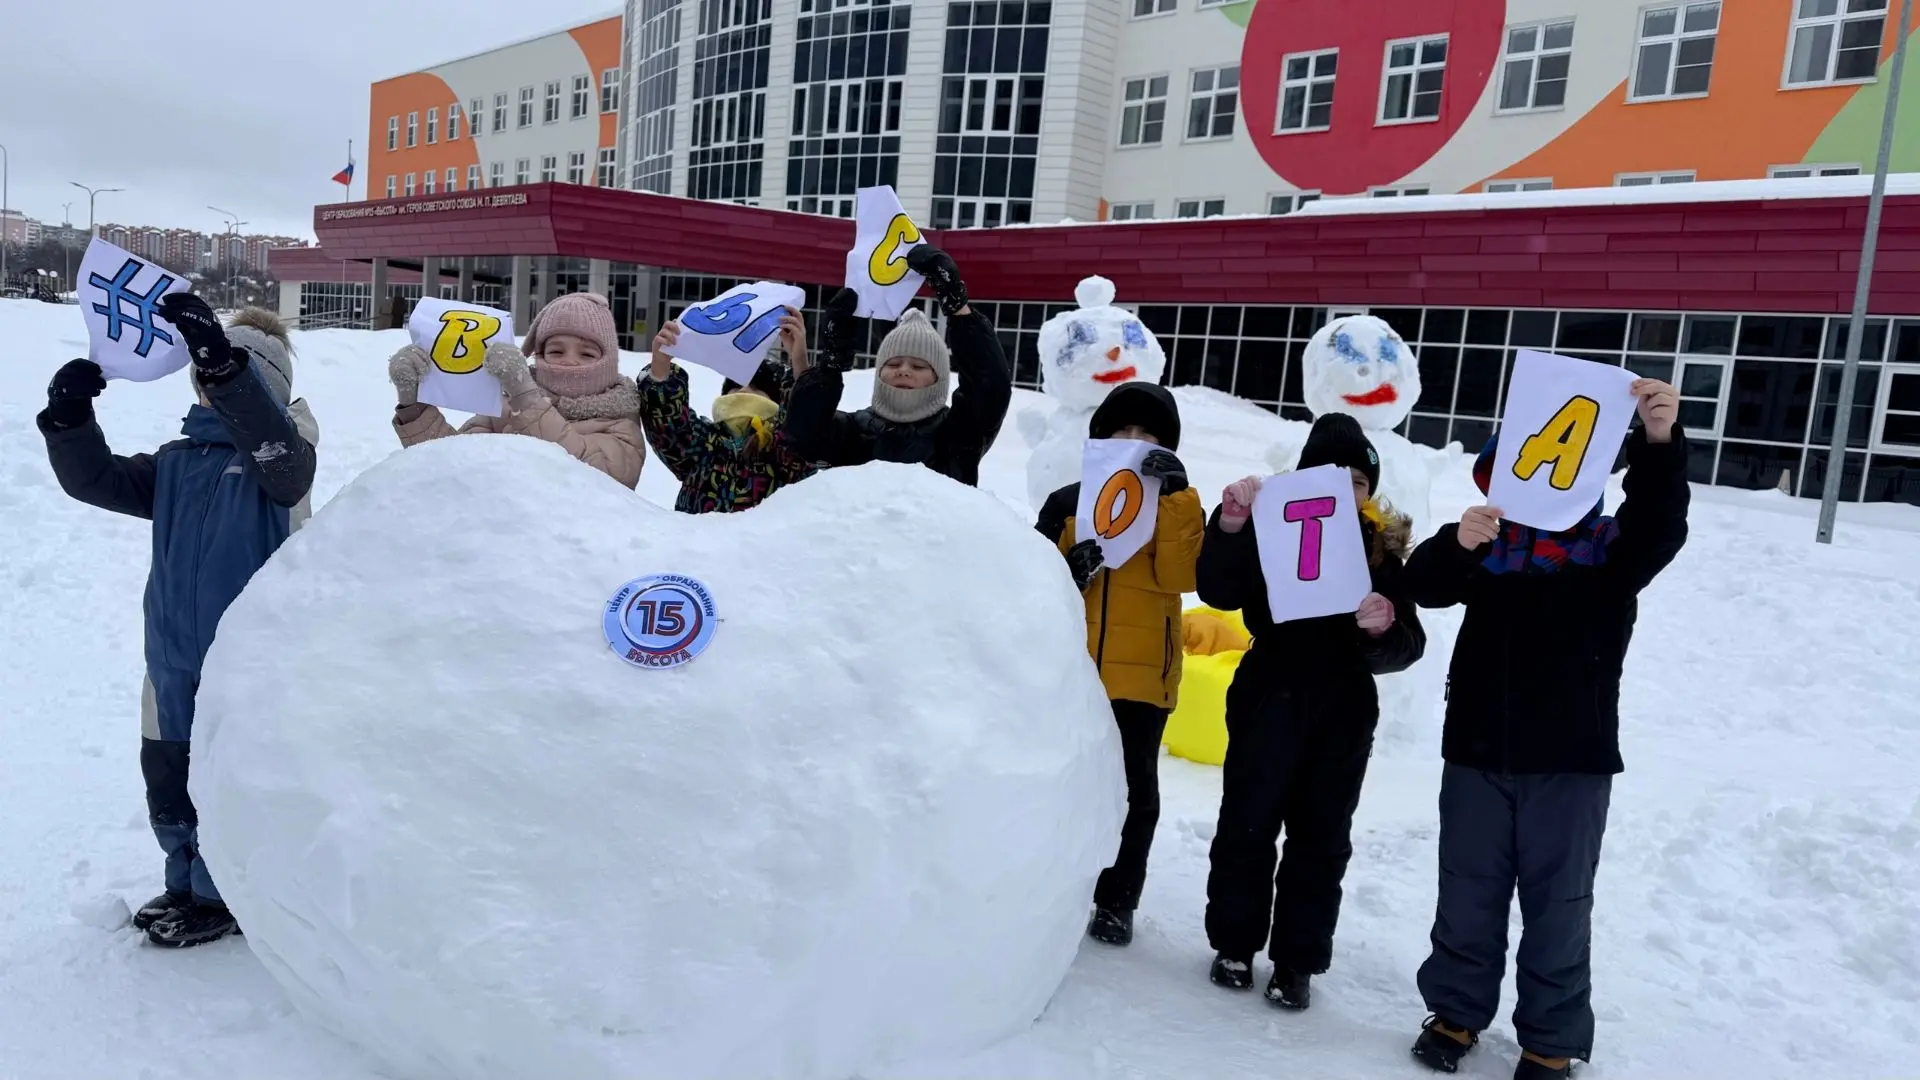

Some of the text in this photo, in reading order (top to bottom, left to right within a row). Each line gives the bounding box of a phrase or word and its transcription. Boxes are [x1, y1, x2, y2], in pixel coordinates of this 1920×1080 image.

[422, 200, 456, 212] СОВЕТСКОГО
[457, 198, 476, 209] СОЮЗА
[868, 213, 920, 286] С
[88, 257, 175, 358] #
[681, 292, 789, 353] Ы
[430, 310, 502, 374] В
[1512, 394, 1600, 491] А
[1093, 468, 1144, 539] О
[1283, 496, 1336, 581] Т
[609, 575, 714, 617] ЦЕНТР ОБРАЗОВАНИЯ
[636, 600, 686, 636] 15
[625, 647, 692, 667] ВЫСОТА
